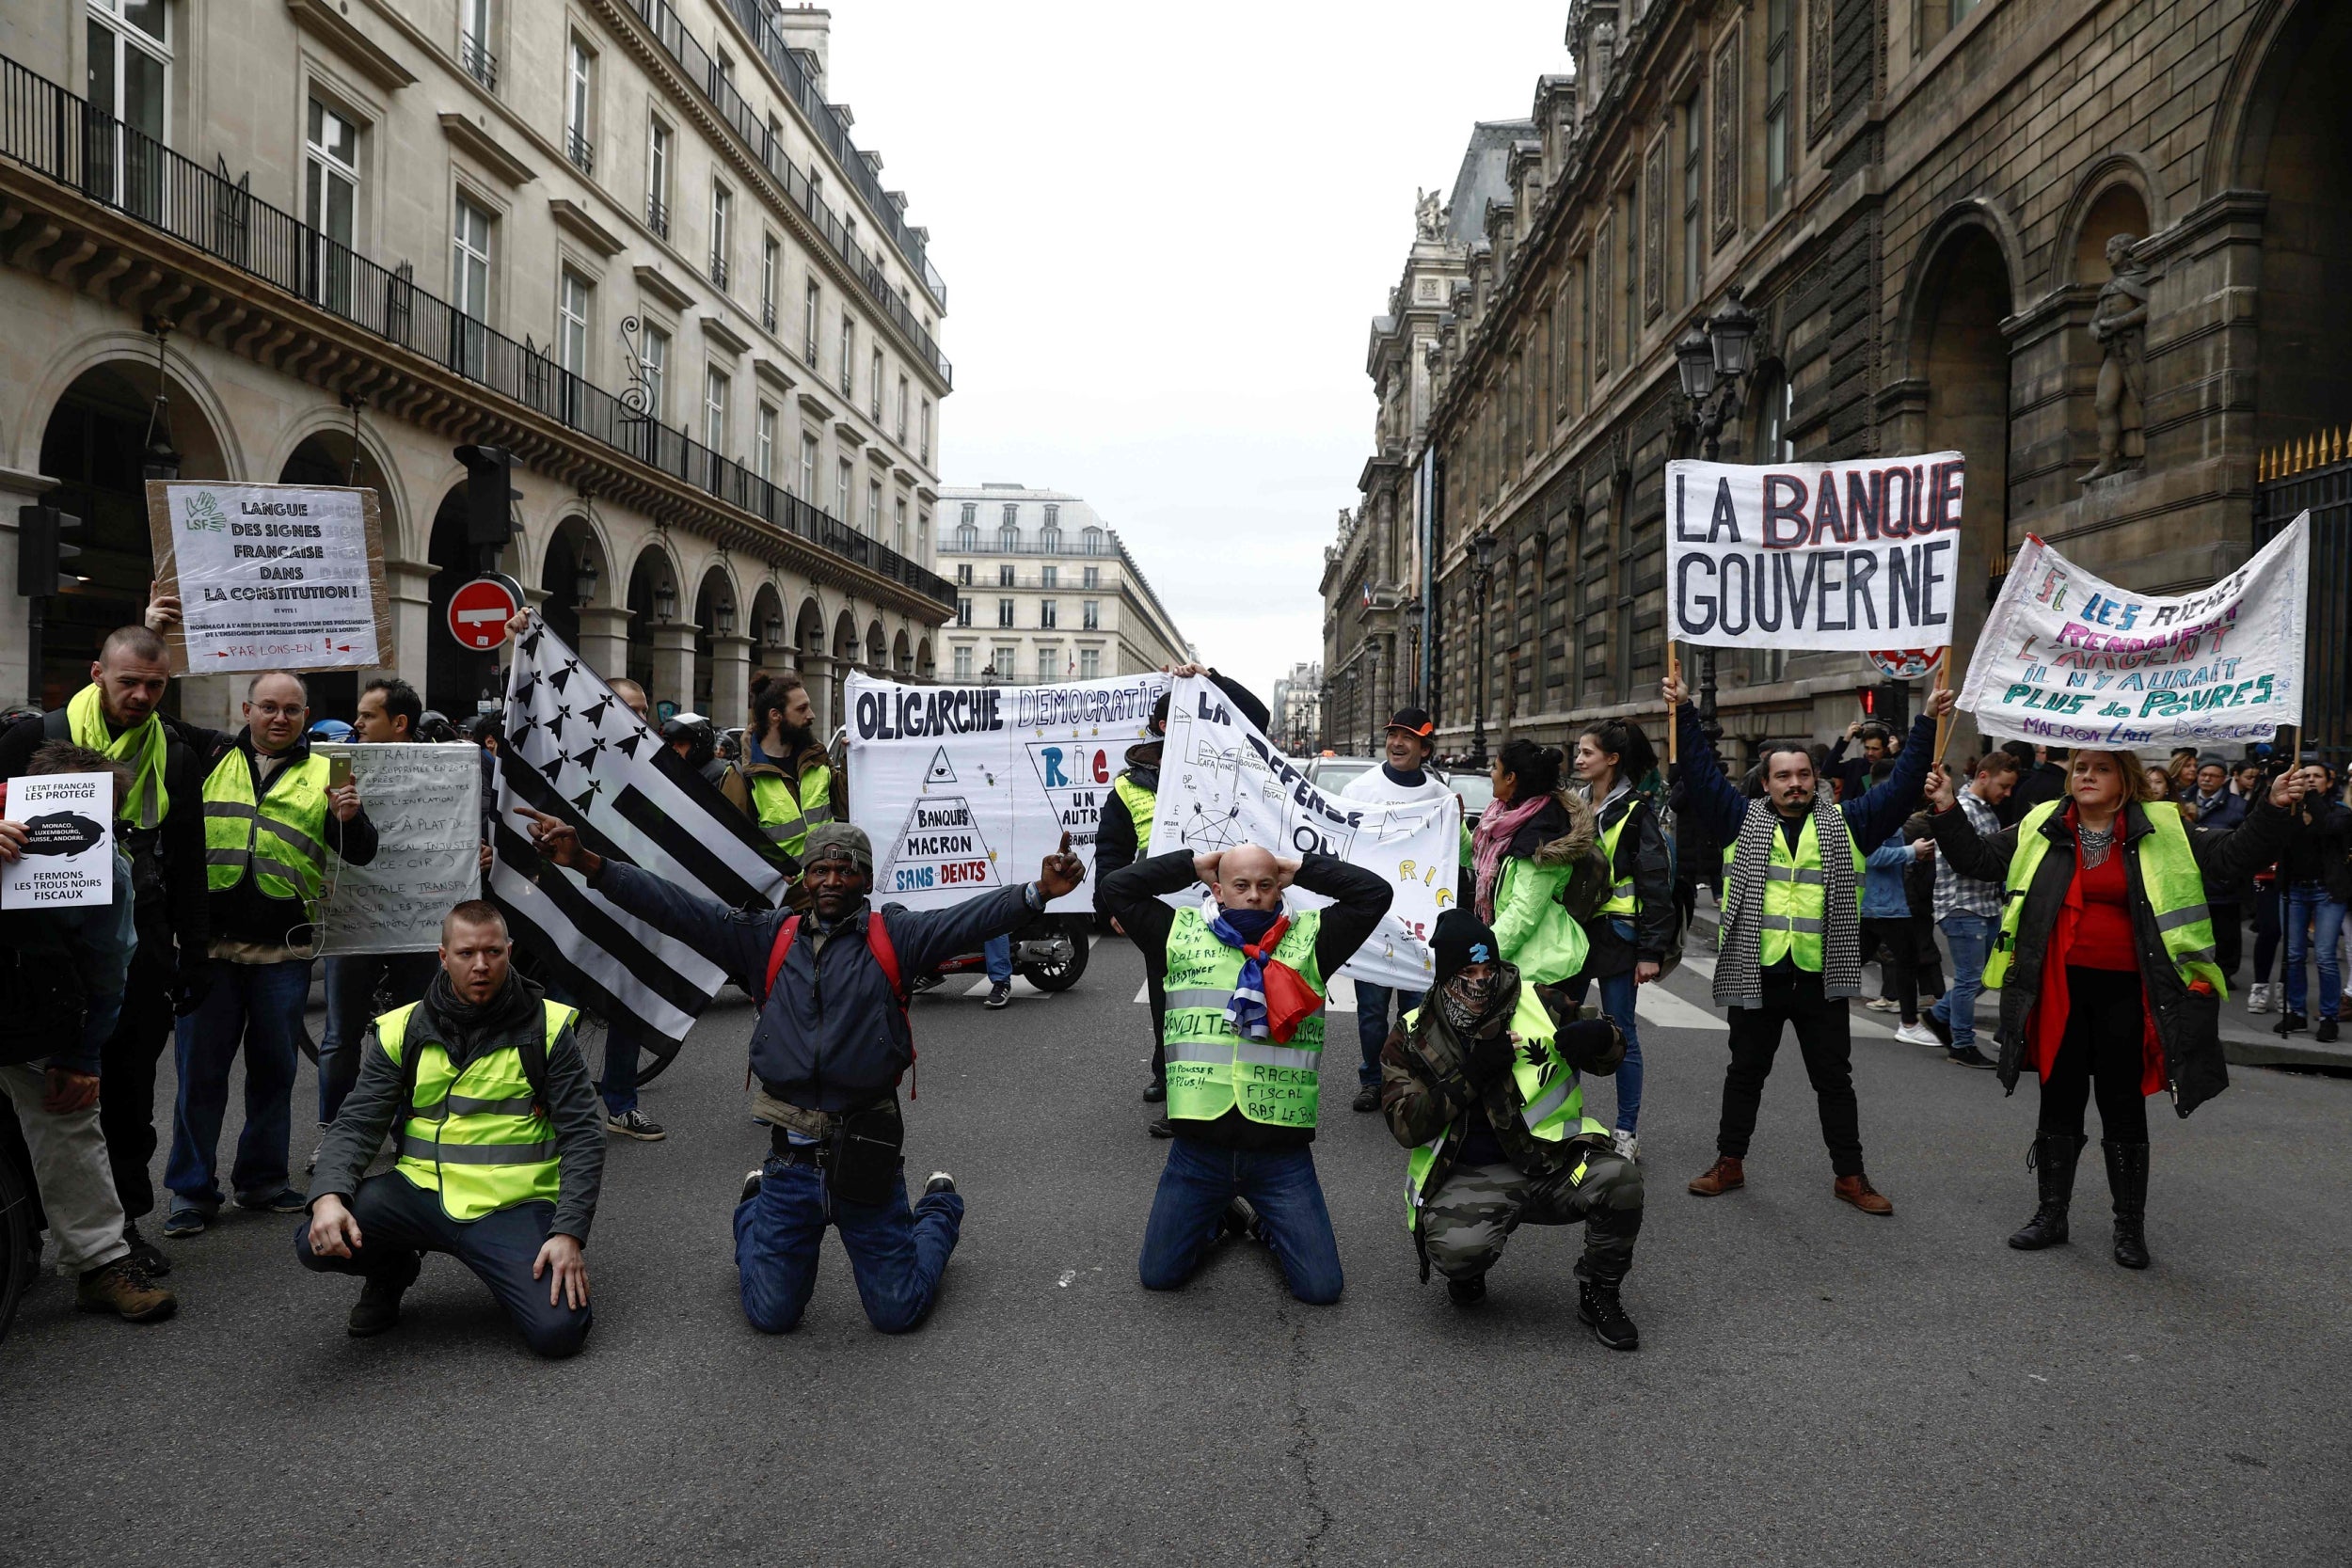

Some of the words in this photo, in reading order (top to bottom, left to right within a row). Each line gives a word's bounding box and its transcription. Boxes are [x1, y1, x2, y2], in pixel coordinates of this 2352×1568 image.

[242, 502, 308, 516] LANGUE
[1676, 474, 1741, 544] LA
[1762, 459, 1964, 549] BANQUE
[186, 519, 209, 531] LSF
[231, 523, 262, 536] DES
[265, 524, 322, 537] SIGNES
[261, 567, 304, 579] DANS
[204, 588, 227, 601] LA
[230, 585, 350, 601] CONSTITUTION
[1677, 540, 1950, 636] GOUVERNE
[2080, 593, 2142, 631] LES
[228, 645, 255, 657] PAR
[2003, 684, 2095, 717] PLUS
[1198, 691, 1232, 726] LA
[2024, 717, 2101, 742] MACRON
[353, 766, 375, 774] CSG
[1199, 758, 1216, 769] GAFA
[1219, 763, 1235, 772] VINCI
[1239, 759, 1270, 773] BOUYGUES
[25, 784, 51, 792] L'ETAT
[25, 792, 42, 800] LES
[45, 790, 96, 800] PROTEGE
[391, 796, 454, 806] L'INFLATION
[1073, 791, 1095, 807] UN
[1263, 790, 1283, 800] TOTAL
[917, 809, 968, 829] BANQUES
[1062, 807, 1102, 827] AUTR
[418, 818, 446, 832] PLAT
[451, 817, 467, 828] DU
[378, 843, 420, 853] FISCAL
[424, 840, 475, 850] INJUSTE
[907, 836, 972, 856] MACRON
[1068, 834, 1097, 847] BANQU
[34, 871, 84, 880] FERMONS
[14, 882, 31, 891] LES
[35, 880, 68, 890] TROUS
[71, 879, 102, 888] NOIRS
[342, 883, 406, 896] TOTALE
[34, 890, 83, 900] FISCAUX
[362, 903, 385, 912] SUR
[390, 902, 412, 911] LES
[1253, 1066, 1313, 1084] RACKET
[1248, 1102, 1275, 1120] RAS
[1281, 1107, 1295, 1120] LE
